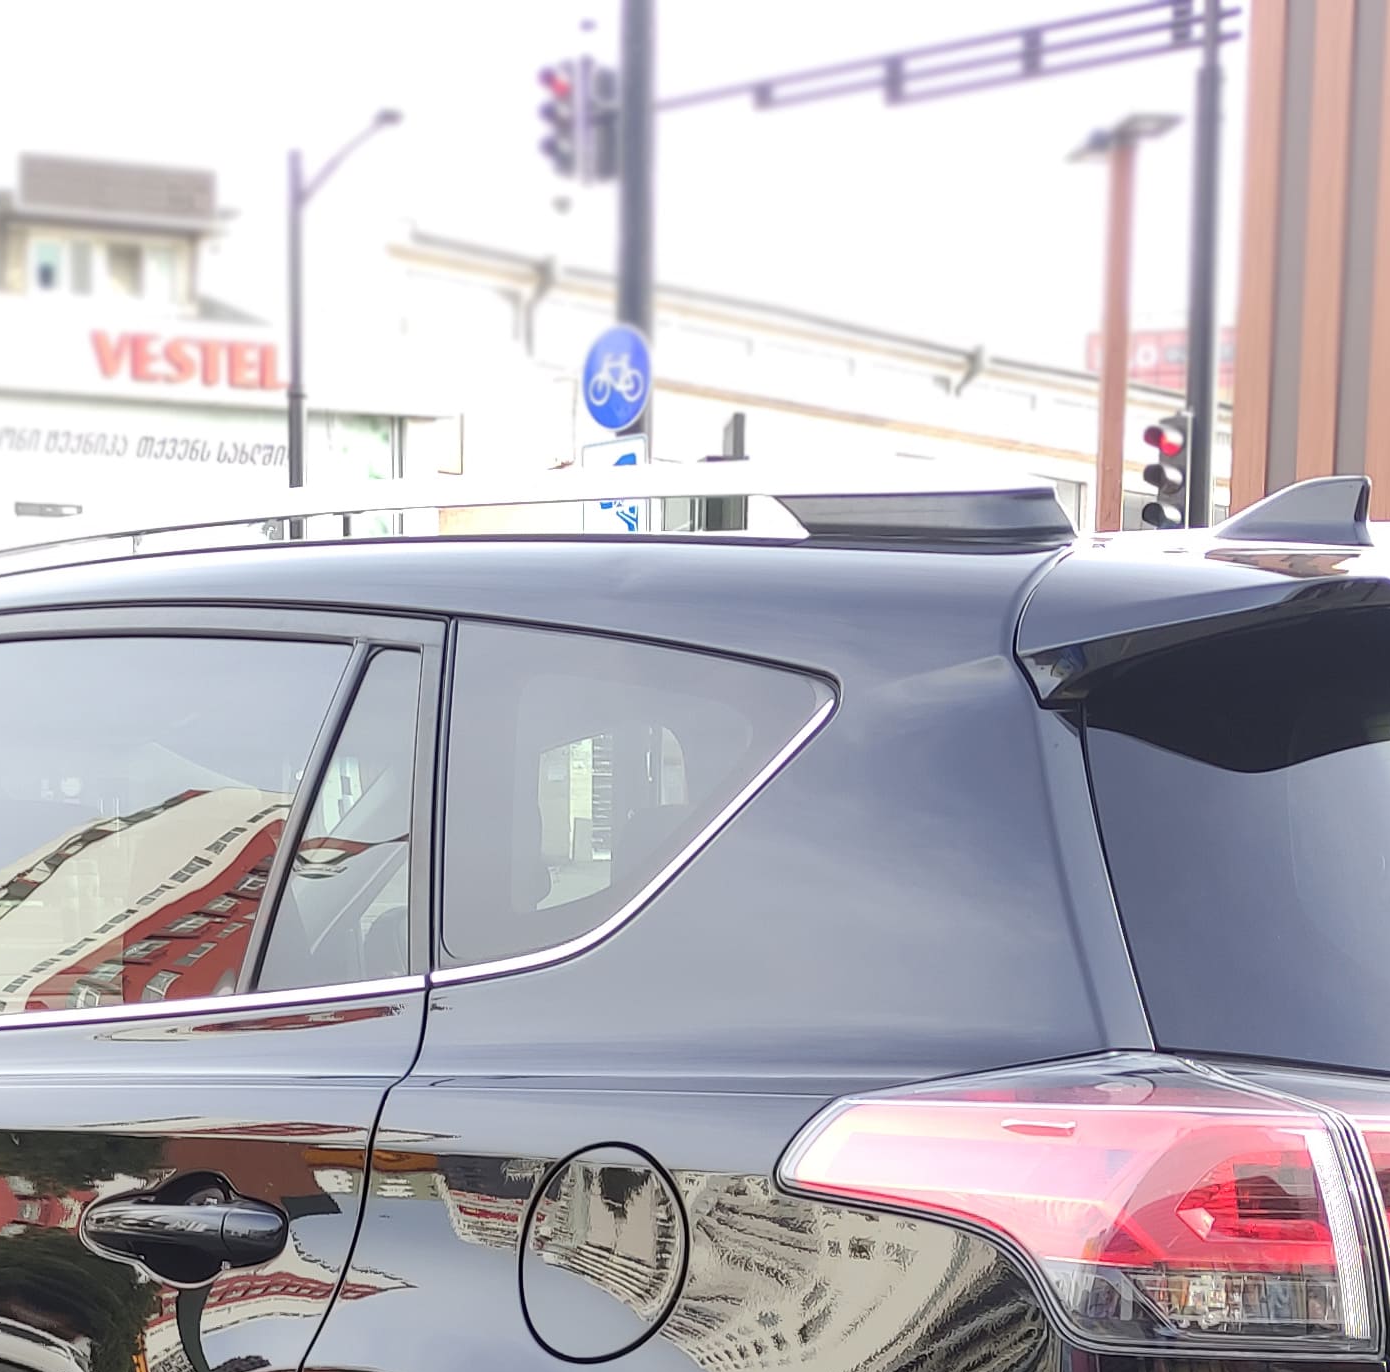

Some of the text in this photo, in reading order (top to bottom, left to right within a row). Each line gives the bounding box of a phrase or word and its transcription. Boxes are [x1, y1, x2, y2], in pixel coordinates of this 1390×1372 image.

[89, 328, 289, 391] VESTEL
[44, 428, 130, 458] ტექნიკა
[136, 435, 212, 463] თქვენს
